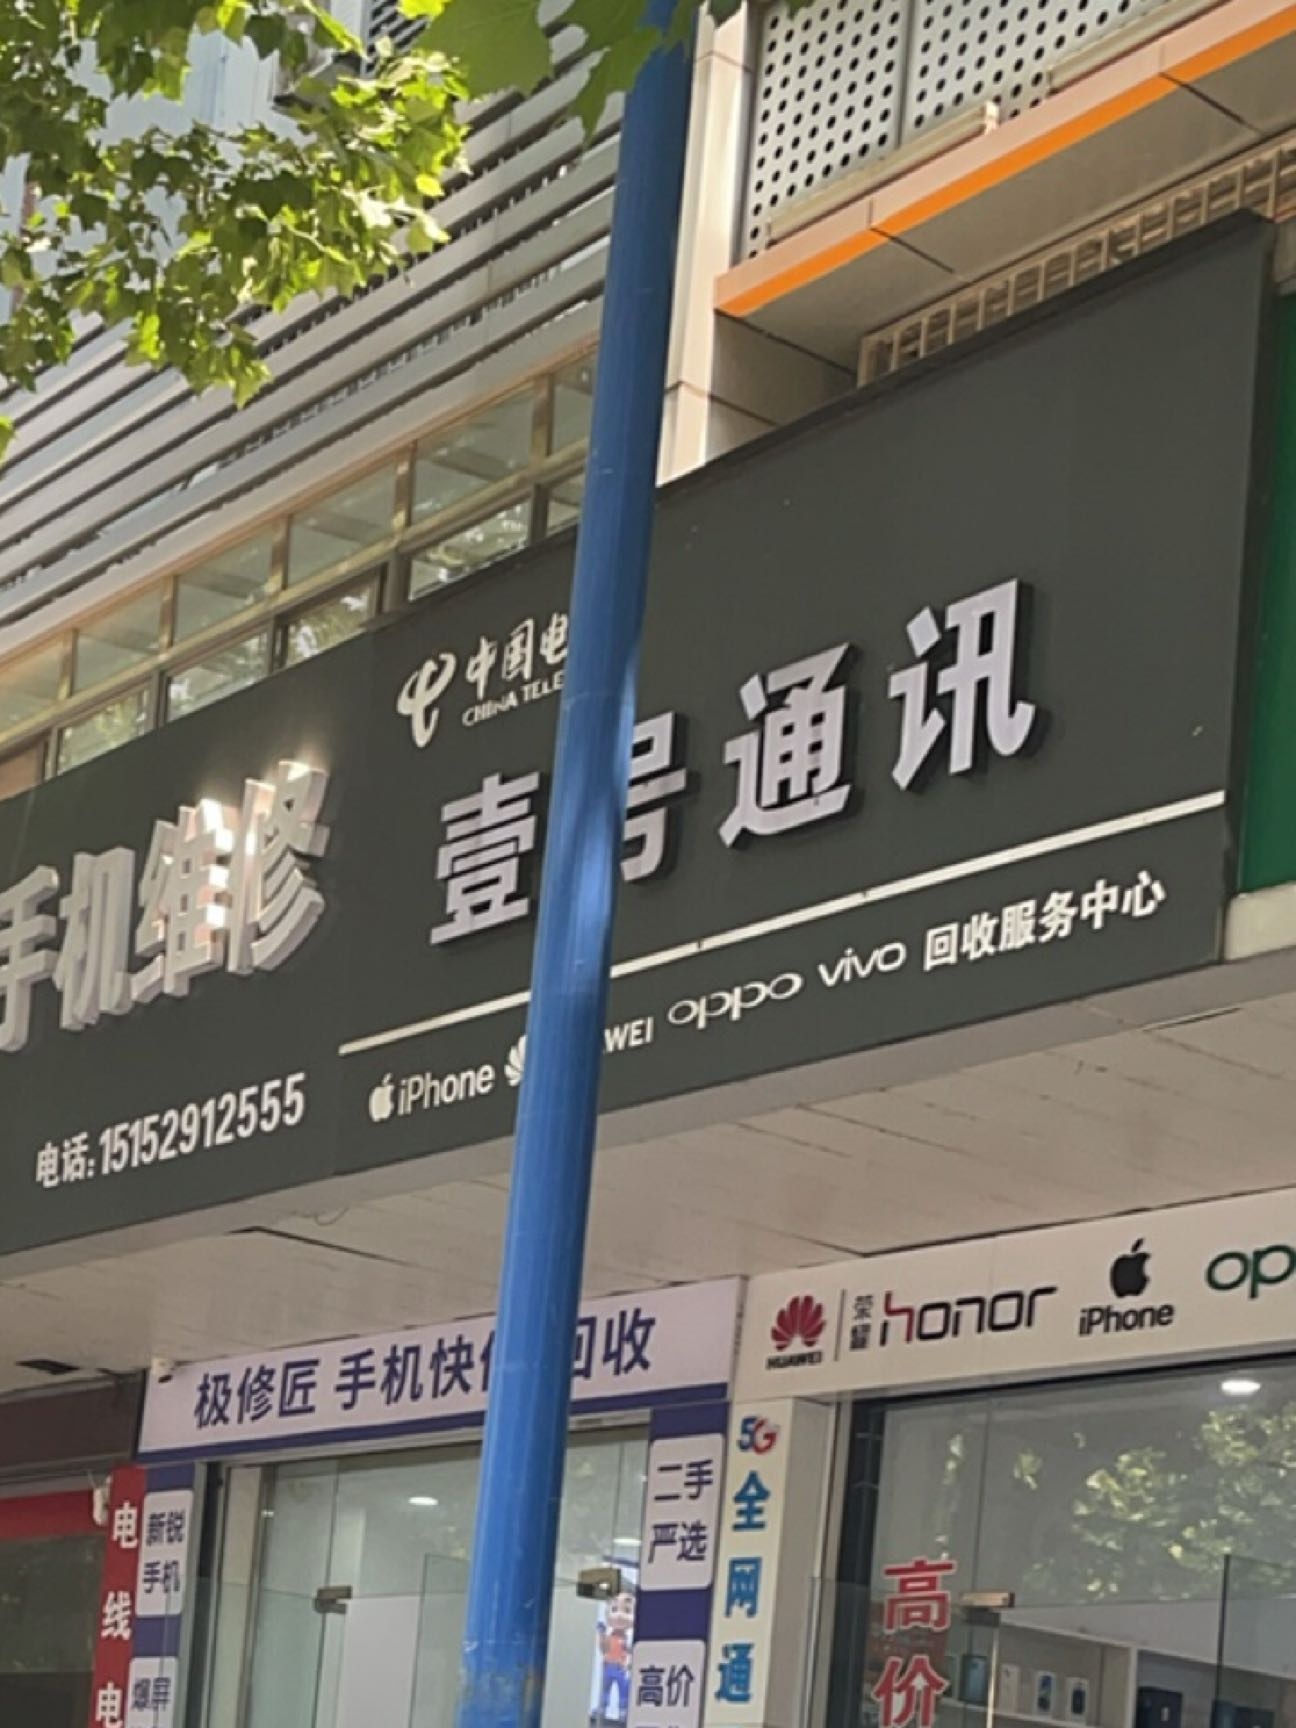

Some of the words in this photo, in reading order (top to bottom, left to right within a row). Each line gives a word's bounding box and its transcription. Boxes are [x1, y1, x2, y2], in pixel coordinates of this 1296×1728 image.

[465, 612, 569, 700] 中国电
[462, 690, 518, 727] CHINA
[520, 670, 567, 704] TELE
[431, 578, 1036, 946] 壹号通讯
[397, 1063, 496, 1116] iPhone
[604, 1016, 654, 1055] WEI
[668, 970, 802, 1030] oppo
[818, 941, 906, 988] vivo
[923, 871, 1167, 971] 回收服务中心
[1206, 1244, 1296, 1299] op
[879, 1285, 1058, 1347] honor
[1078, 1301, 1174, 1337] iPhone
[194, 1357, 321, 1430] 极修匠
[654, 1459, 714, 1501] 二手
[647, 1520, 708, 1564] 严选
[143, 1559, 181, 1594] 手机
[636, 1664, 695, 1709] 高价
